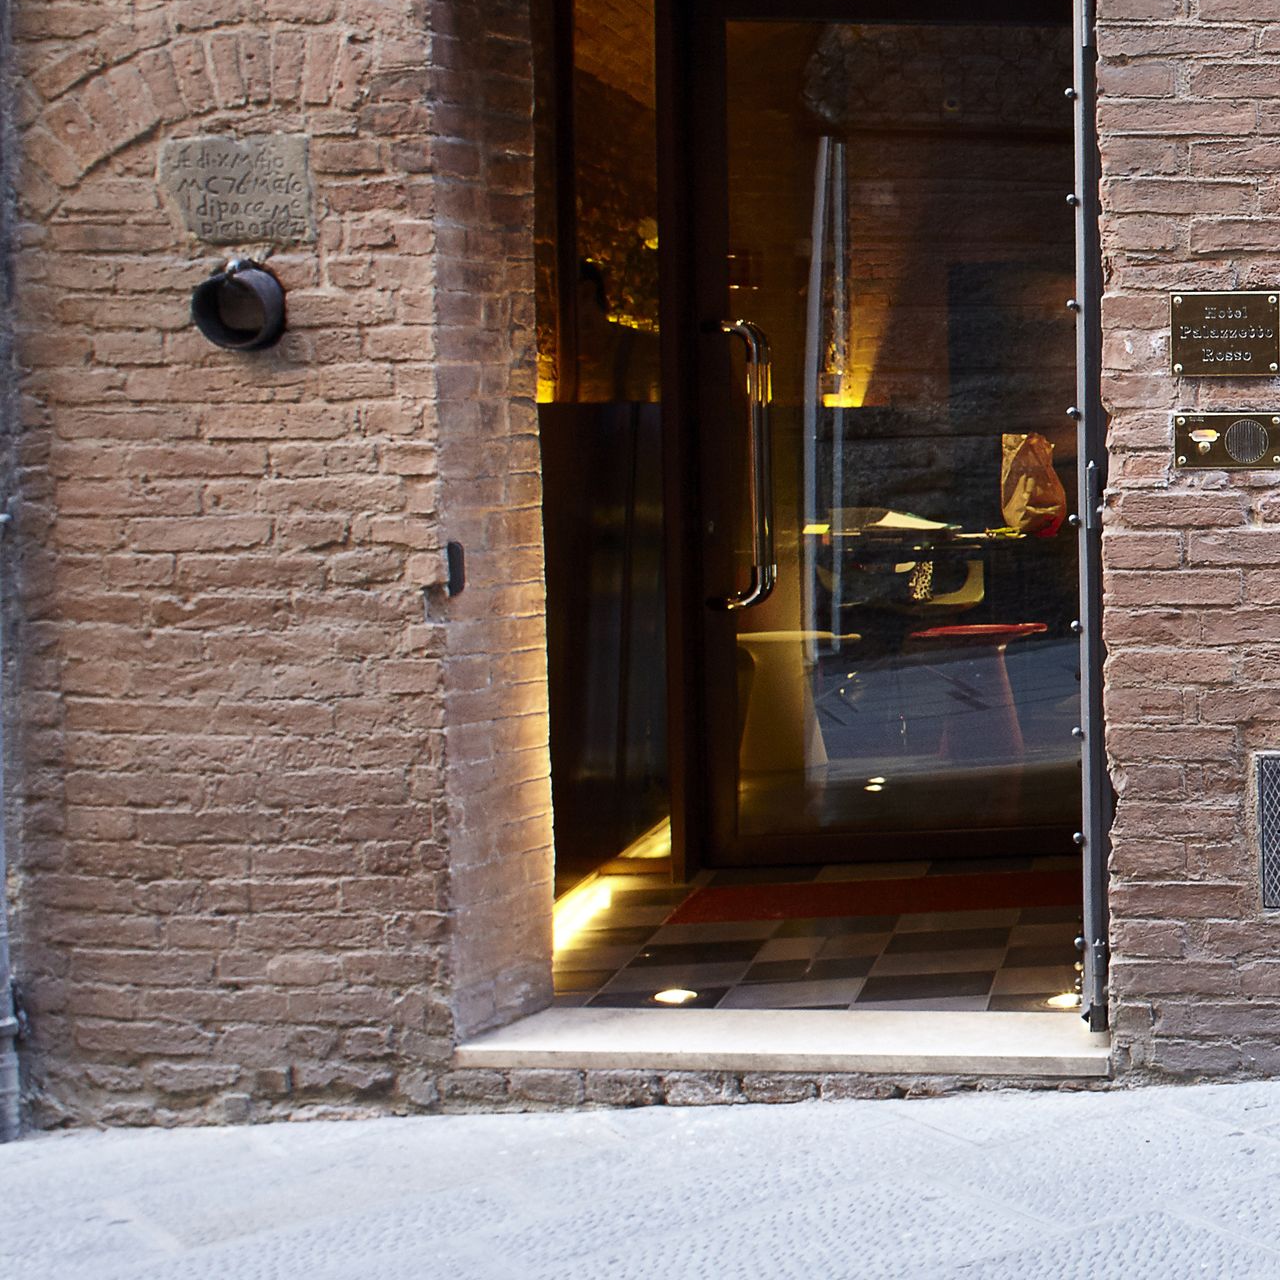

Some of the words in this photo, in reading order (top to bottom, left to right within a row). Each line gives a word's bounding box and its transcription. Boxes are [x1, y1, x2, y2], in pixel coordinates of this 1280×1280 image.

[1204, 306, 1248, 319] Hotel
[1180, 325, 1273, 339] Palazzetto
[1202, 348, 1252, 362] Rosso
